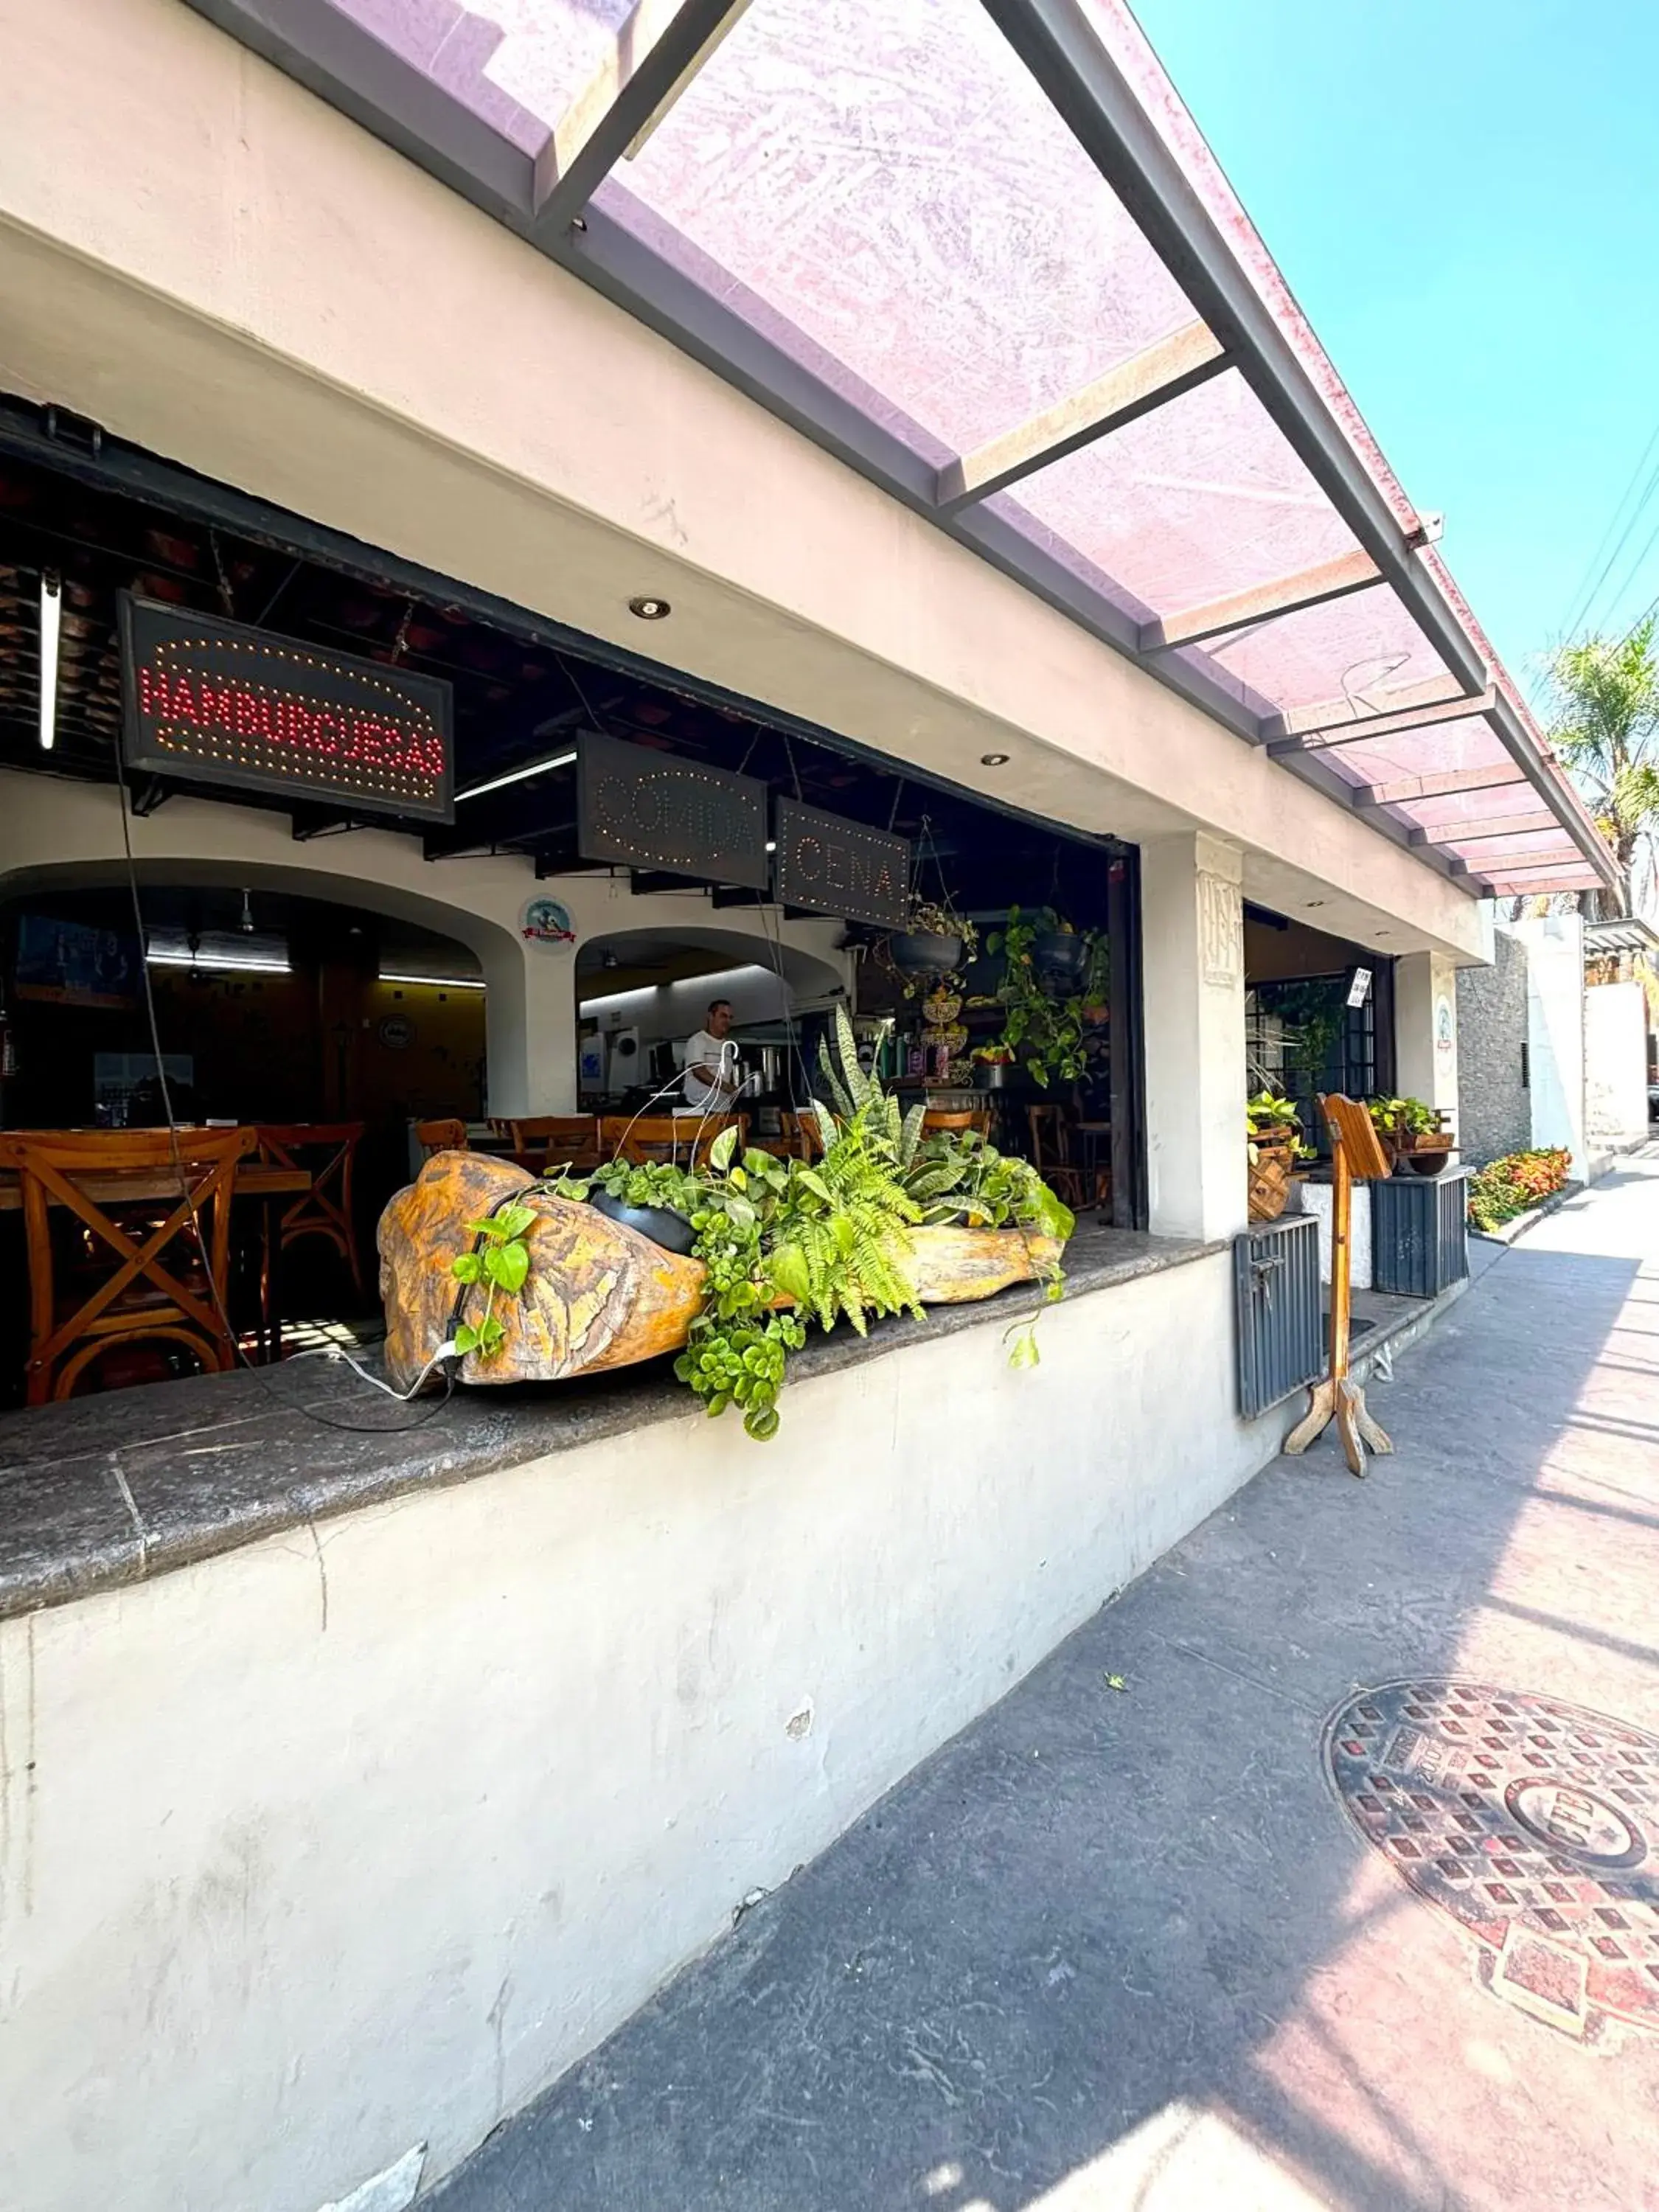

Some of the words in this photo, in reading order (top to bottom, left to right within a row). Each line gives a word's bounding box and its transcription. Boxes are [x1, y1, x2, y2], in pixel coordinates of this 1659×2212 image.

[139, 667, 445, 776] HAMBURGUESAS
[596, 775, 756, 857] COMIDA
[796, 837, 894, 901] CENA
[1547, 1790, 1595, 1848] CFE
